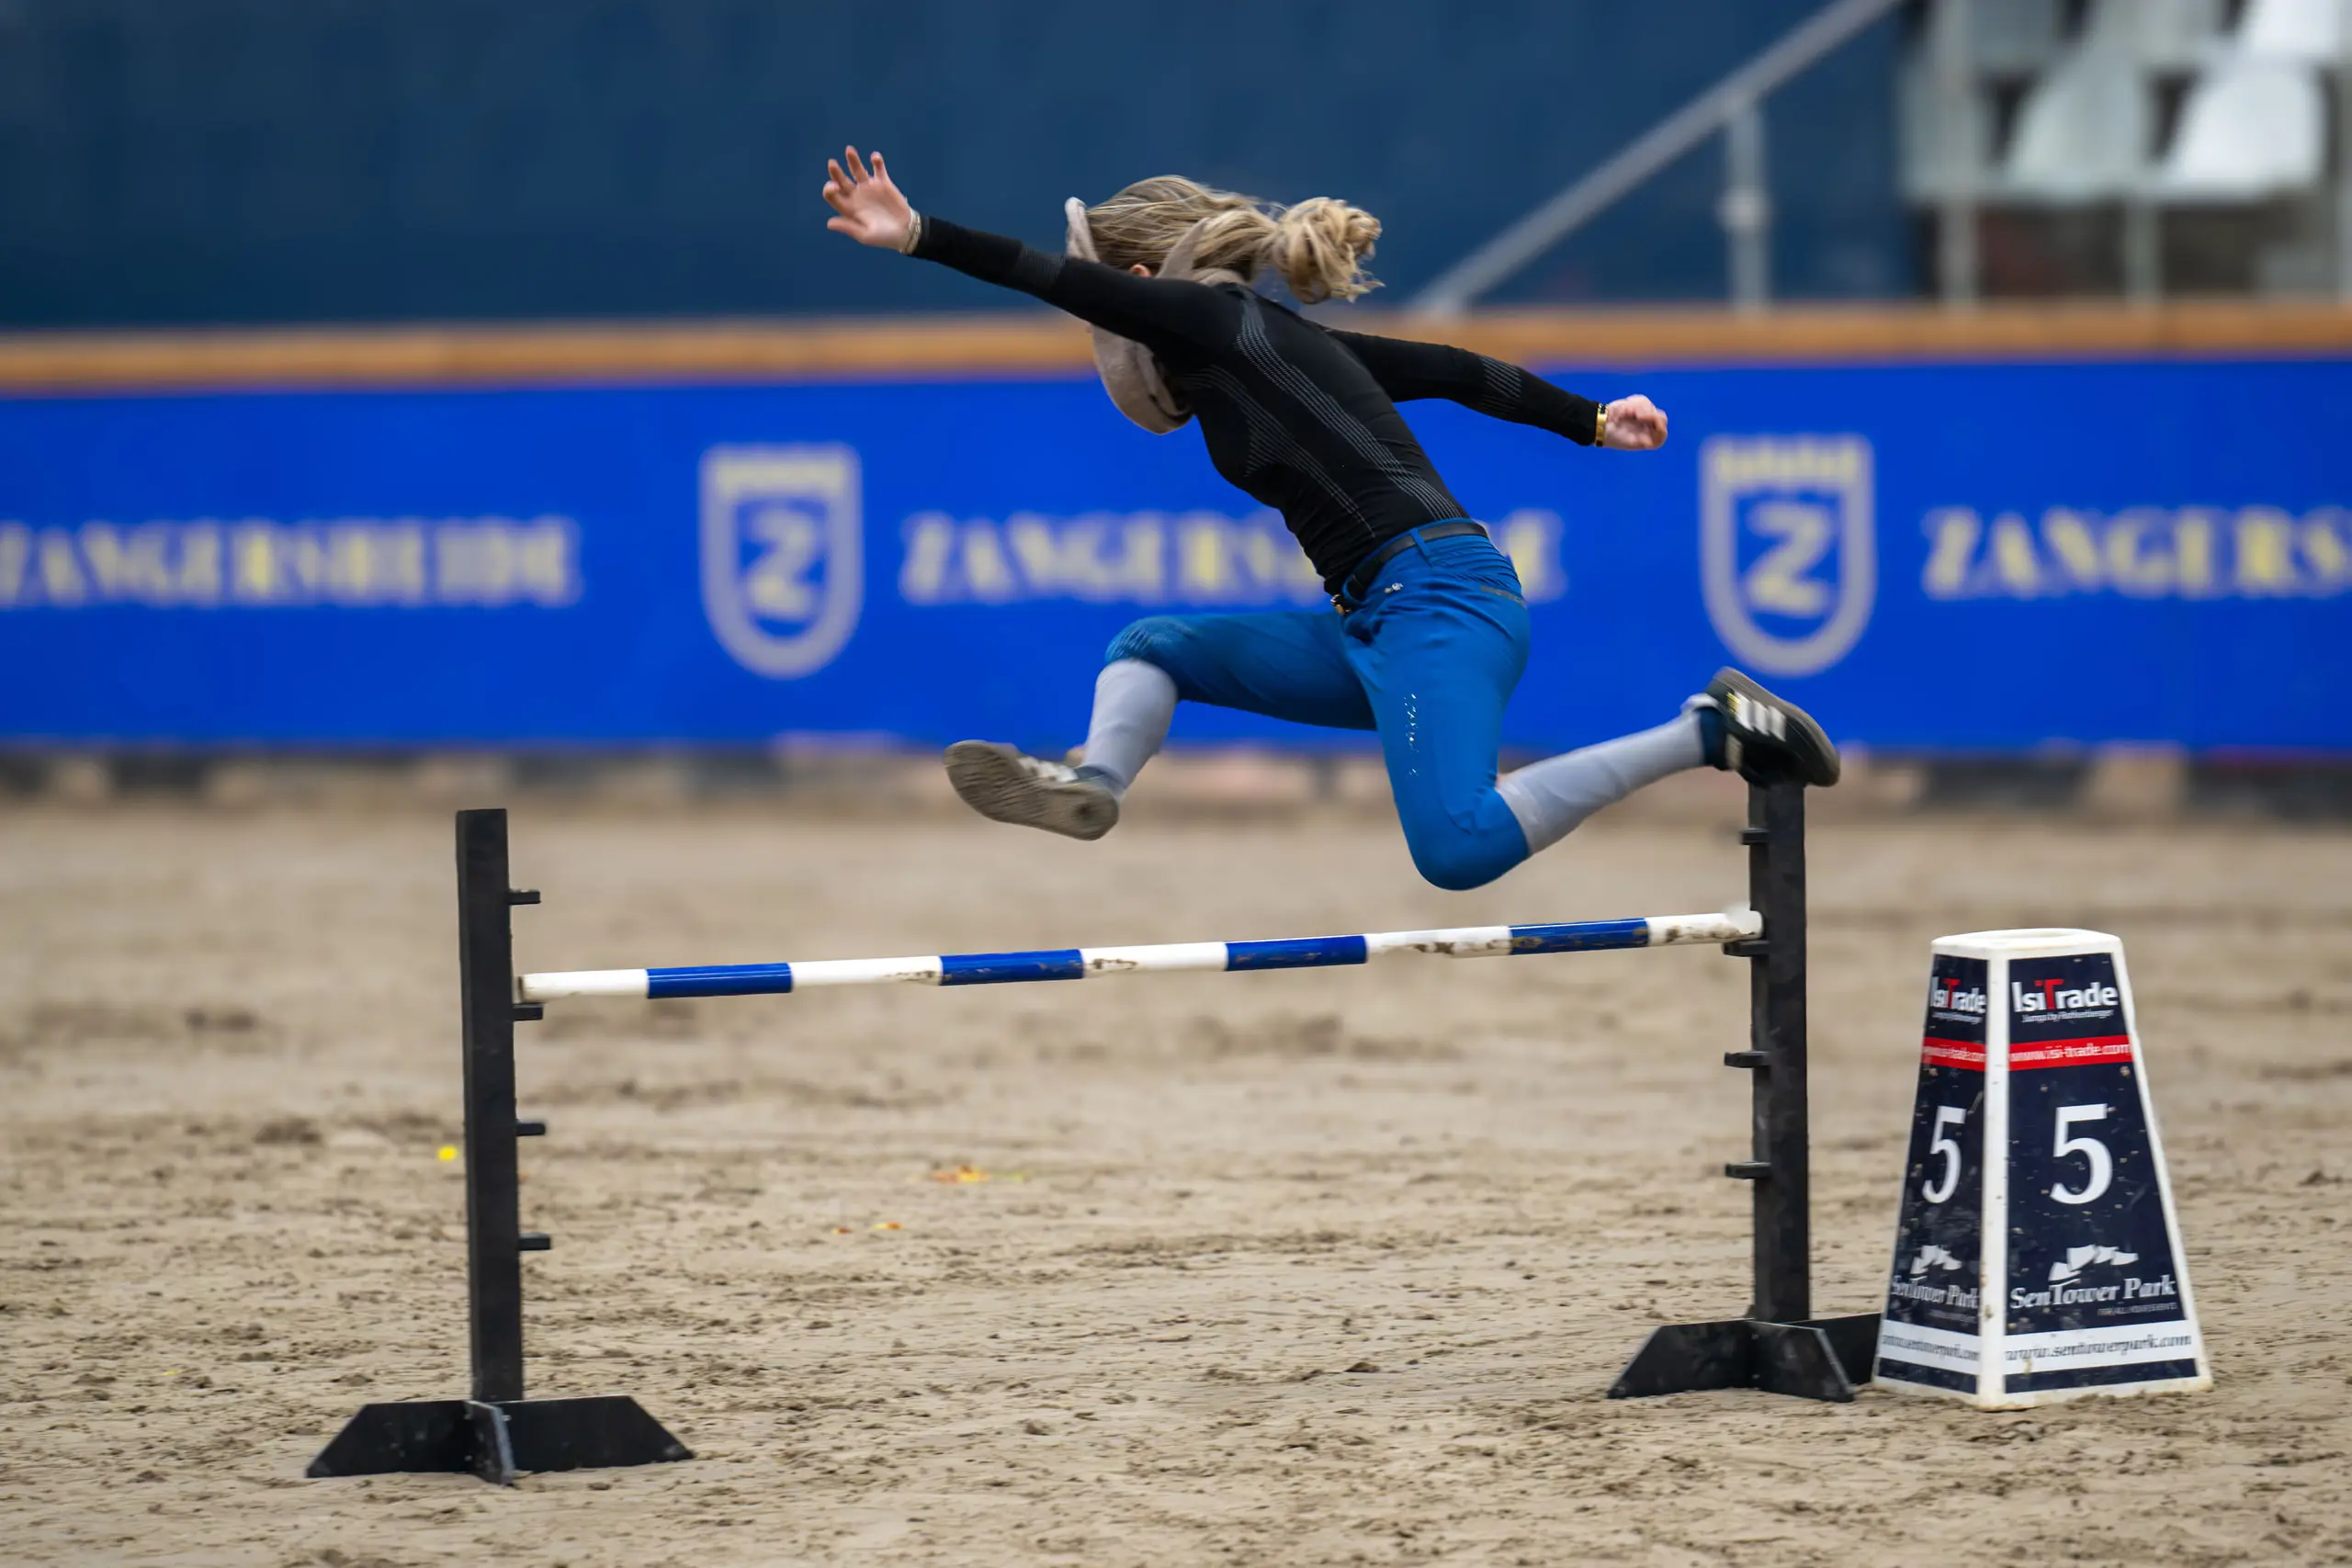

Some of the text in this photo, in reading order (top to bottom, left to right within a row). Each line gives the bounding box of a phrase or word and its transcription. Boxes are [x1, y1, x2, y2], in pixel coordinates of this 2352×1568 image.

[1922, 1105, 1966, 1203] 5
[2050, 1103, 2112, 1204] 5
[2010, 1283, 2120, 1309] SenTower
[2122, 1274, 2176, 1300] Park
